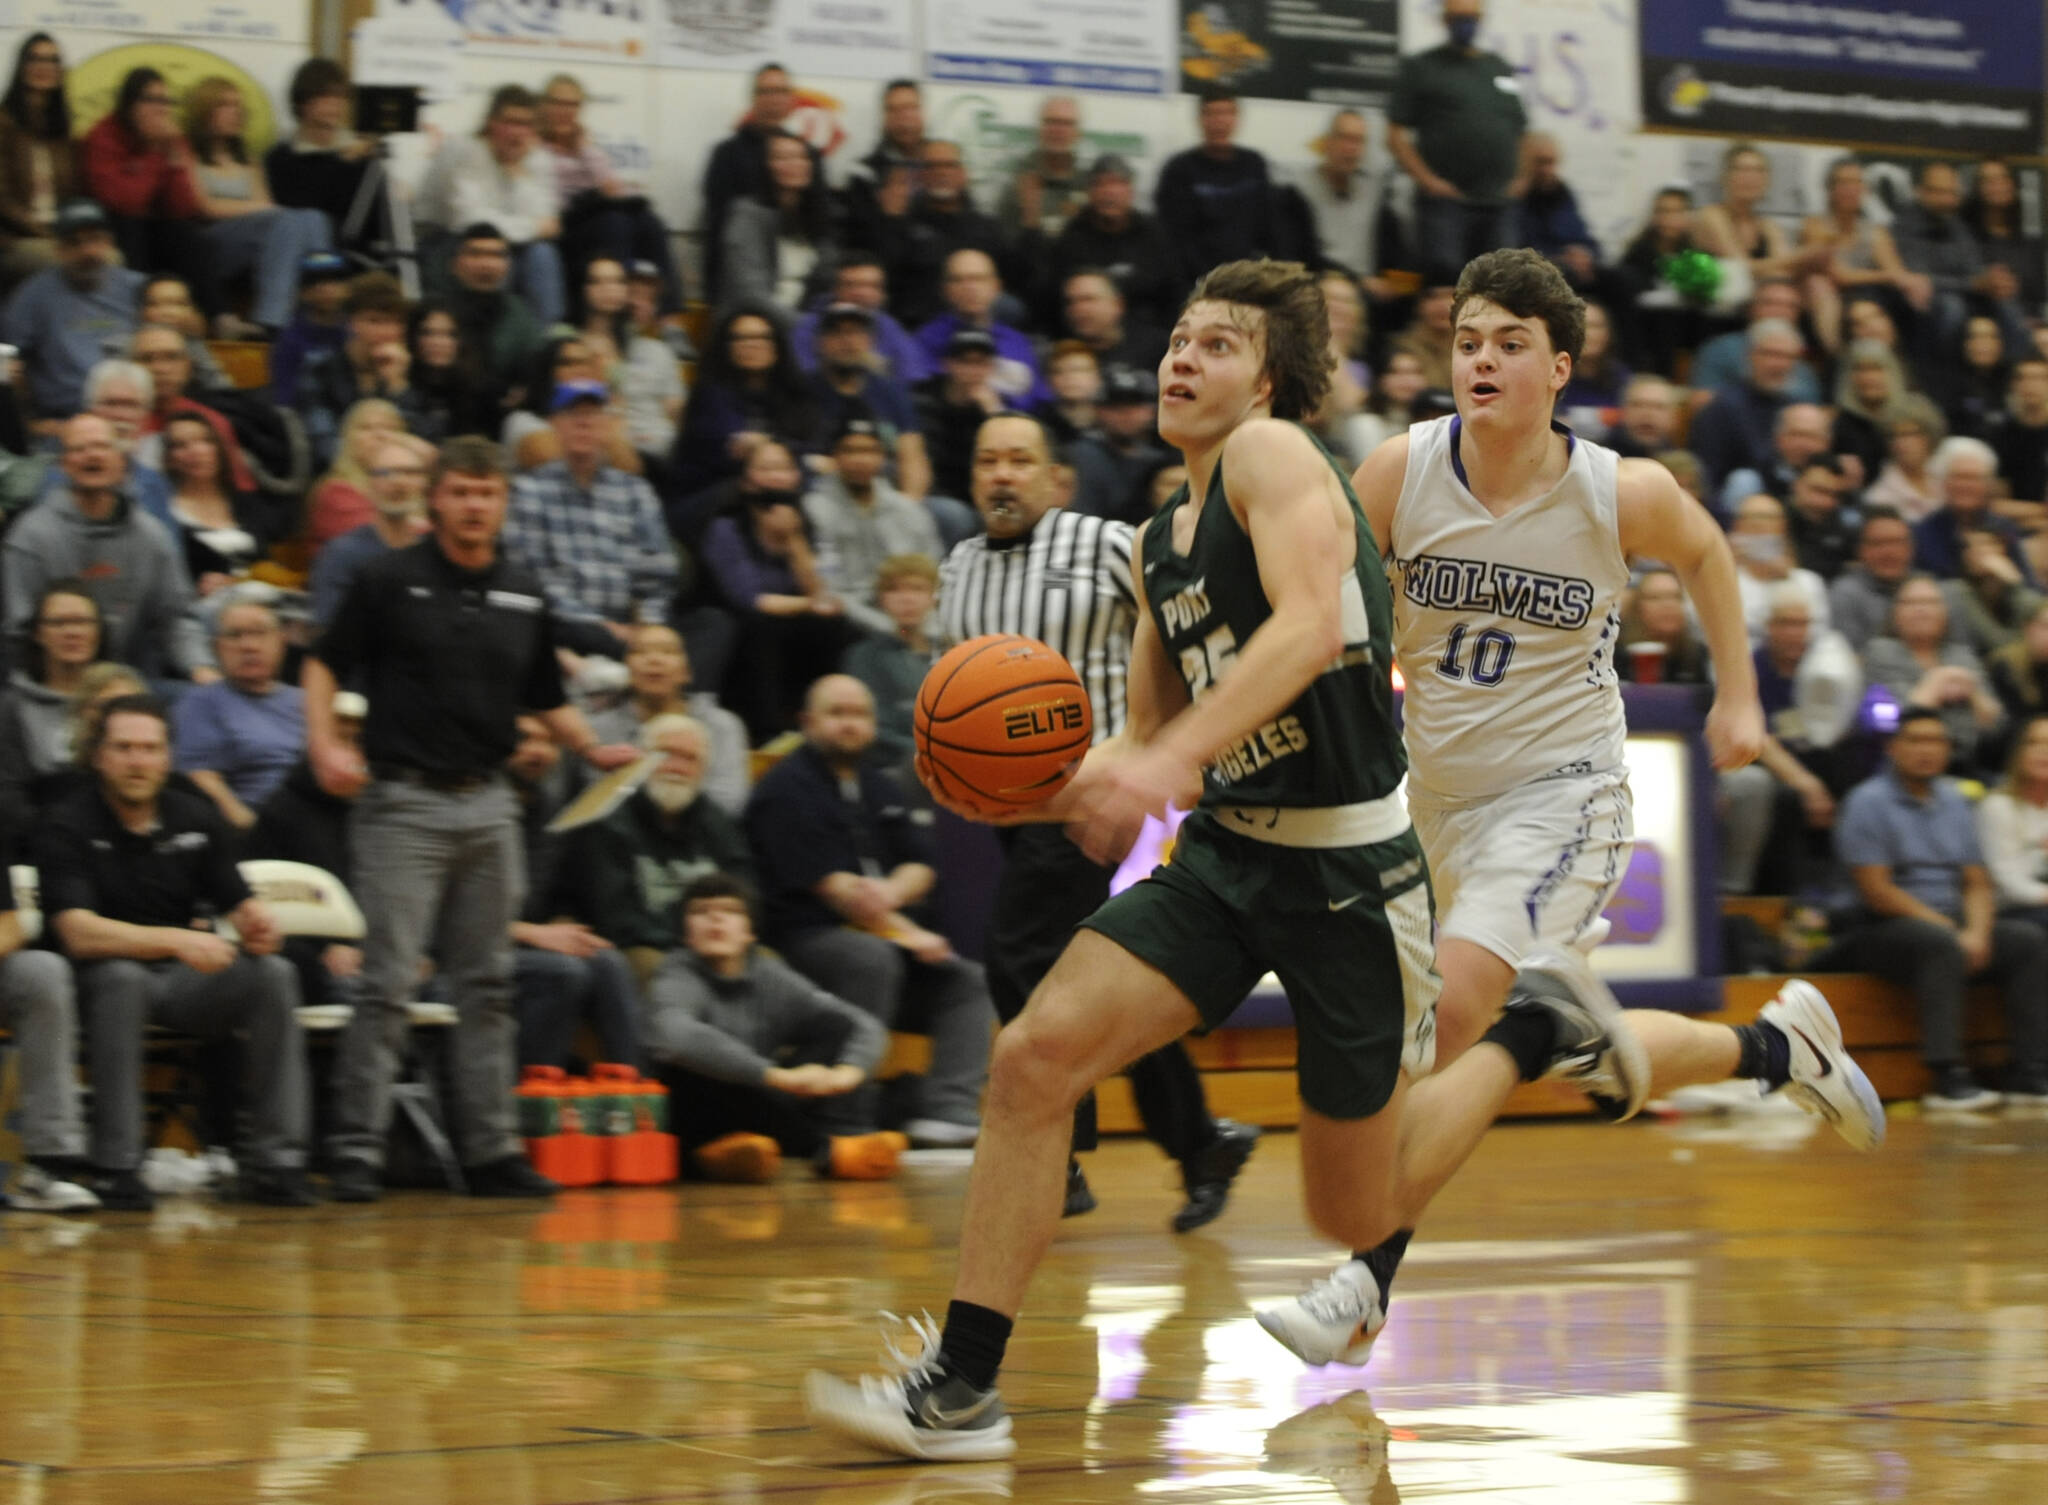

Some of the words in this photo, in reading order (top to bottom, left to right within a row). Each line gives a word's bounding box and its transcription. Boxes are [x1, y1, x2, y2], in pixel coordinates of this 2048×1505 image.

[1398, 554, 1595, 631] WOLVES
[1436, 622, 1517, 688] 10
[1005, 702, 1083, 739] ELITE
